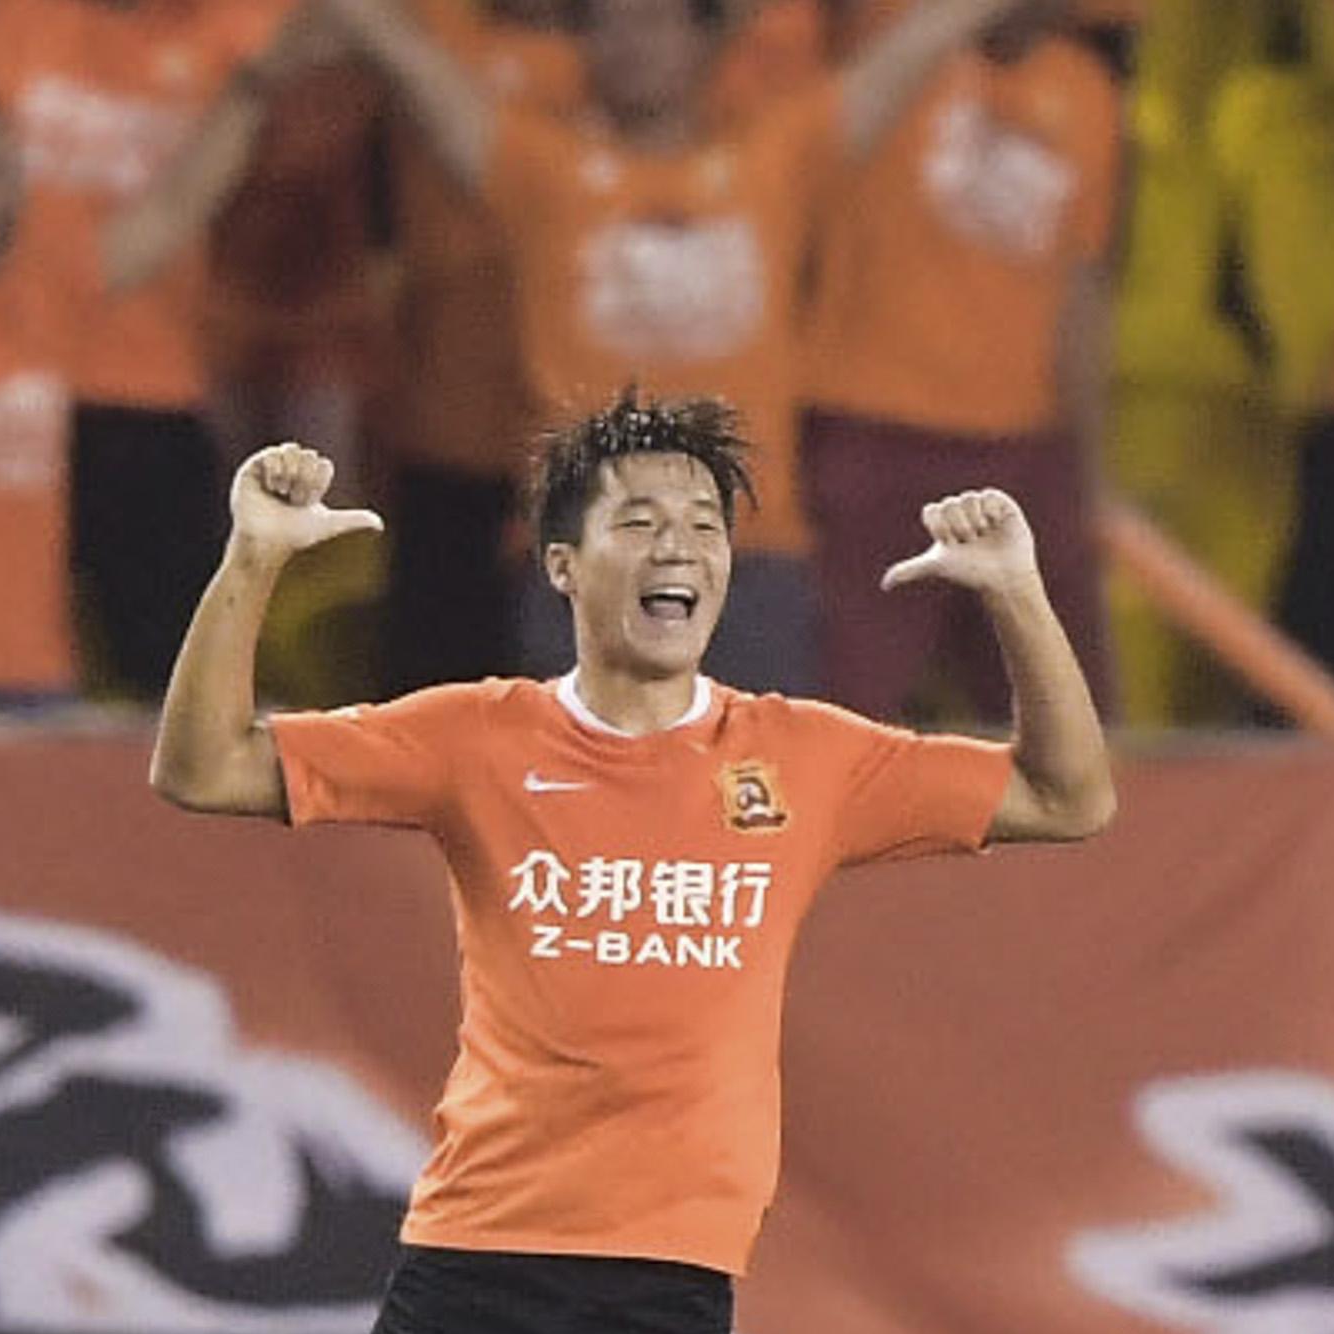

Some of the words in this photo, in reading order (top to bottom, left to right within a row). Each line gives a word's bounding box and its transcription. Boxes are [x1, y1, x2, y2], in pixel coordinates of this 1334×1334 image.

[509, 850, 771, 927] 众邦银行
[531, 926, 742, 968] Z-BANK
